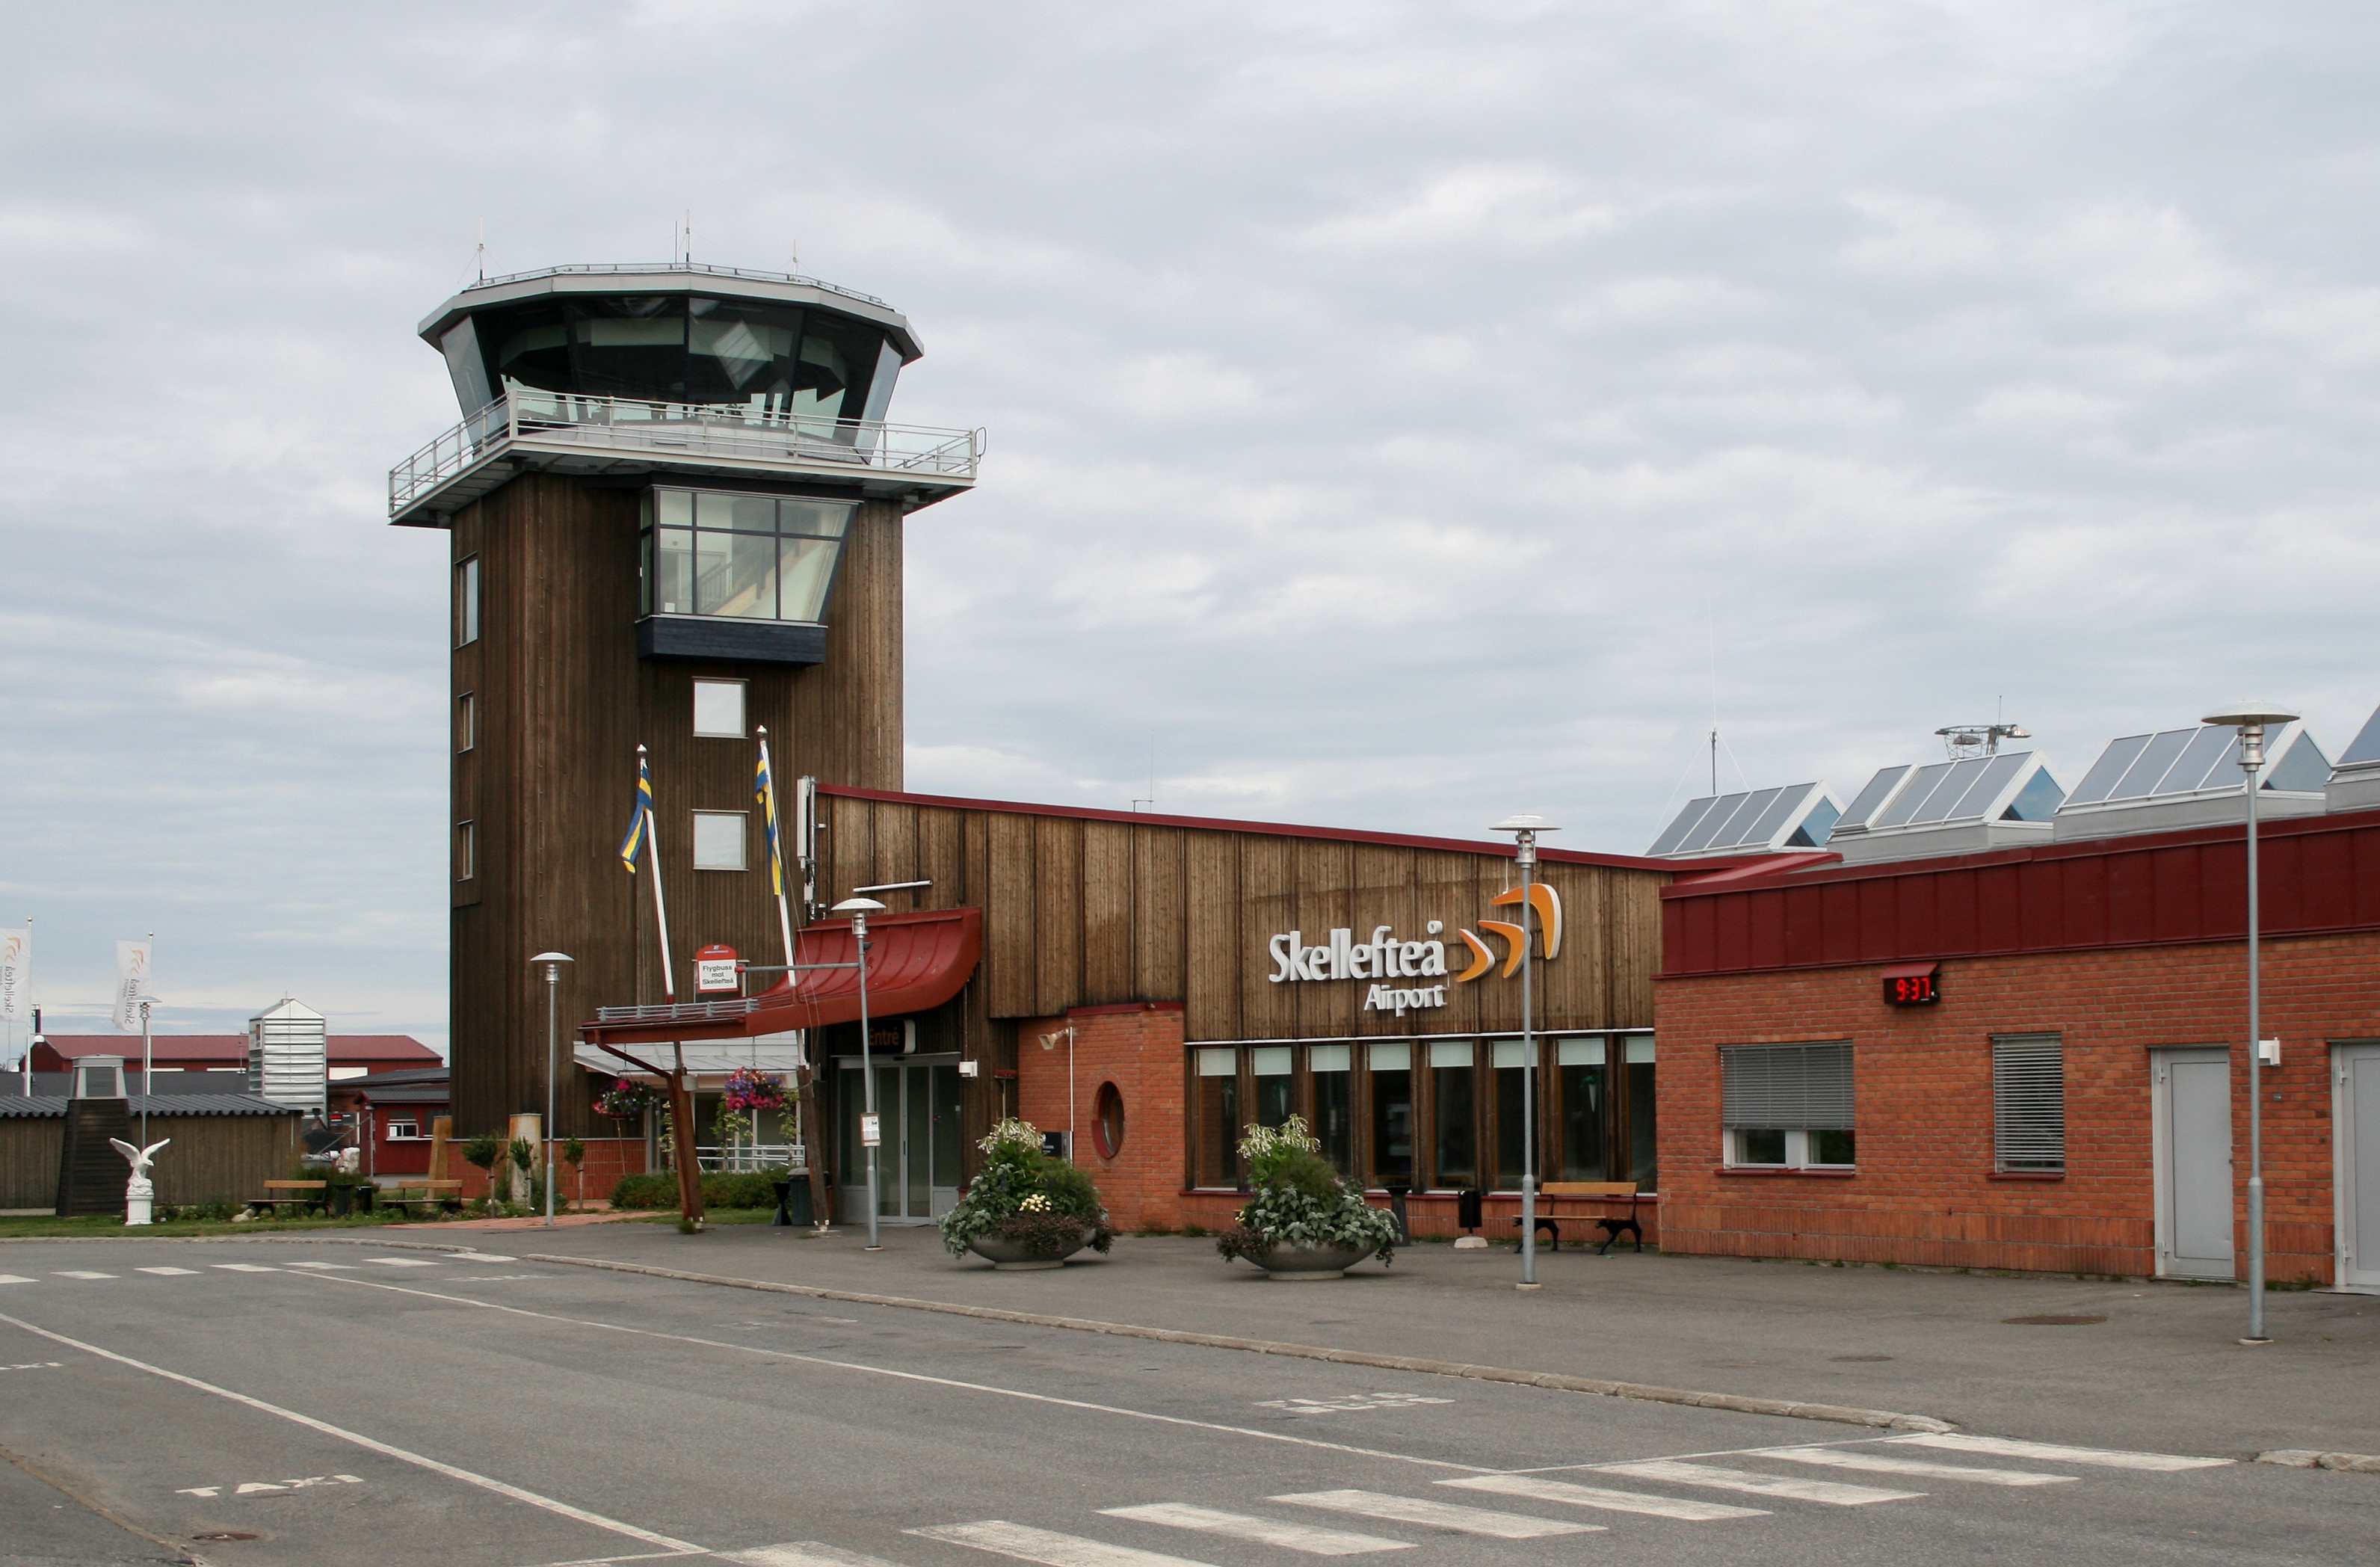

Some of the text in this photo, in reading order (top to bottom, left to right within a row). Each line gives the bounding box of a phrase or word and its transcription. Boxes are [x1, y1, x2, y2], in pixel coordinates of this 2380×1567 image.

[1268, 920, 1448, 982] Skellefteå
[1364, 984, 1448, 1017] Airport
[1896, 977, 1931, 1001] 9:37
[869, 1026, 900, 1046] Entré
[175, 1474, 365, 1497] TAXI
